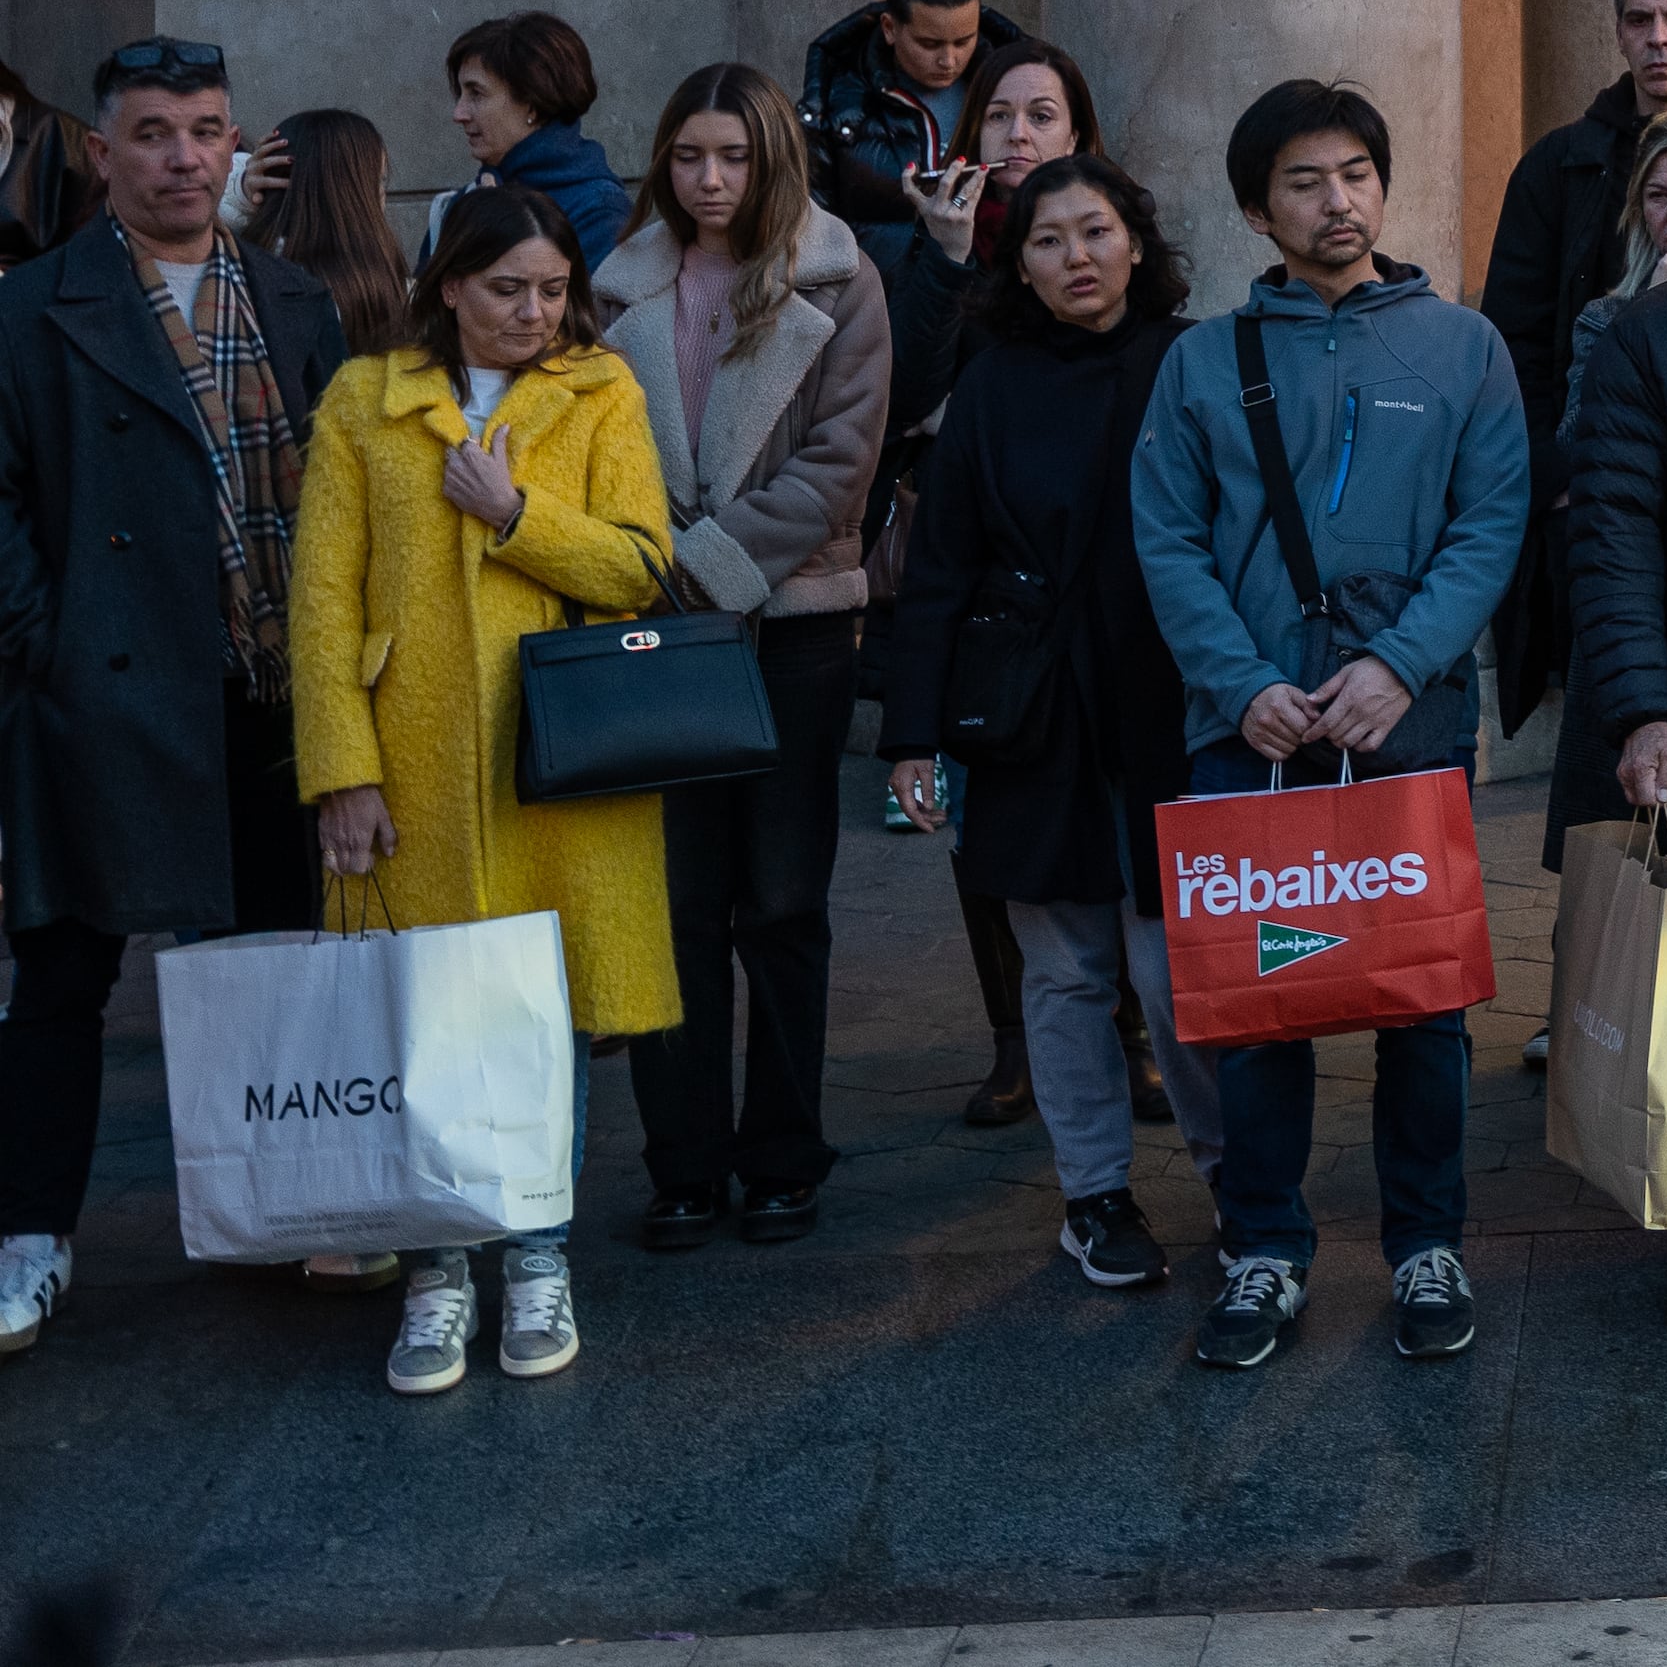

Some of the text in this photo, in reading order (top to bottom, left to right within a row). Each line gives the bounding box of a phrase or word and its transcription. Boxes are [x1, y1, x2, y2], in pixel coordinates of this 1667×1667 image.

[1175, 851, 1226, 877] Les
[1178, 850, 1428, 919] rebaixes
[1261, 939, 1272, 951] El
[1272, 938, 1293, 951] Corte
[245, 1075, 401, 1122] MANGO
